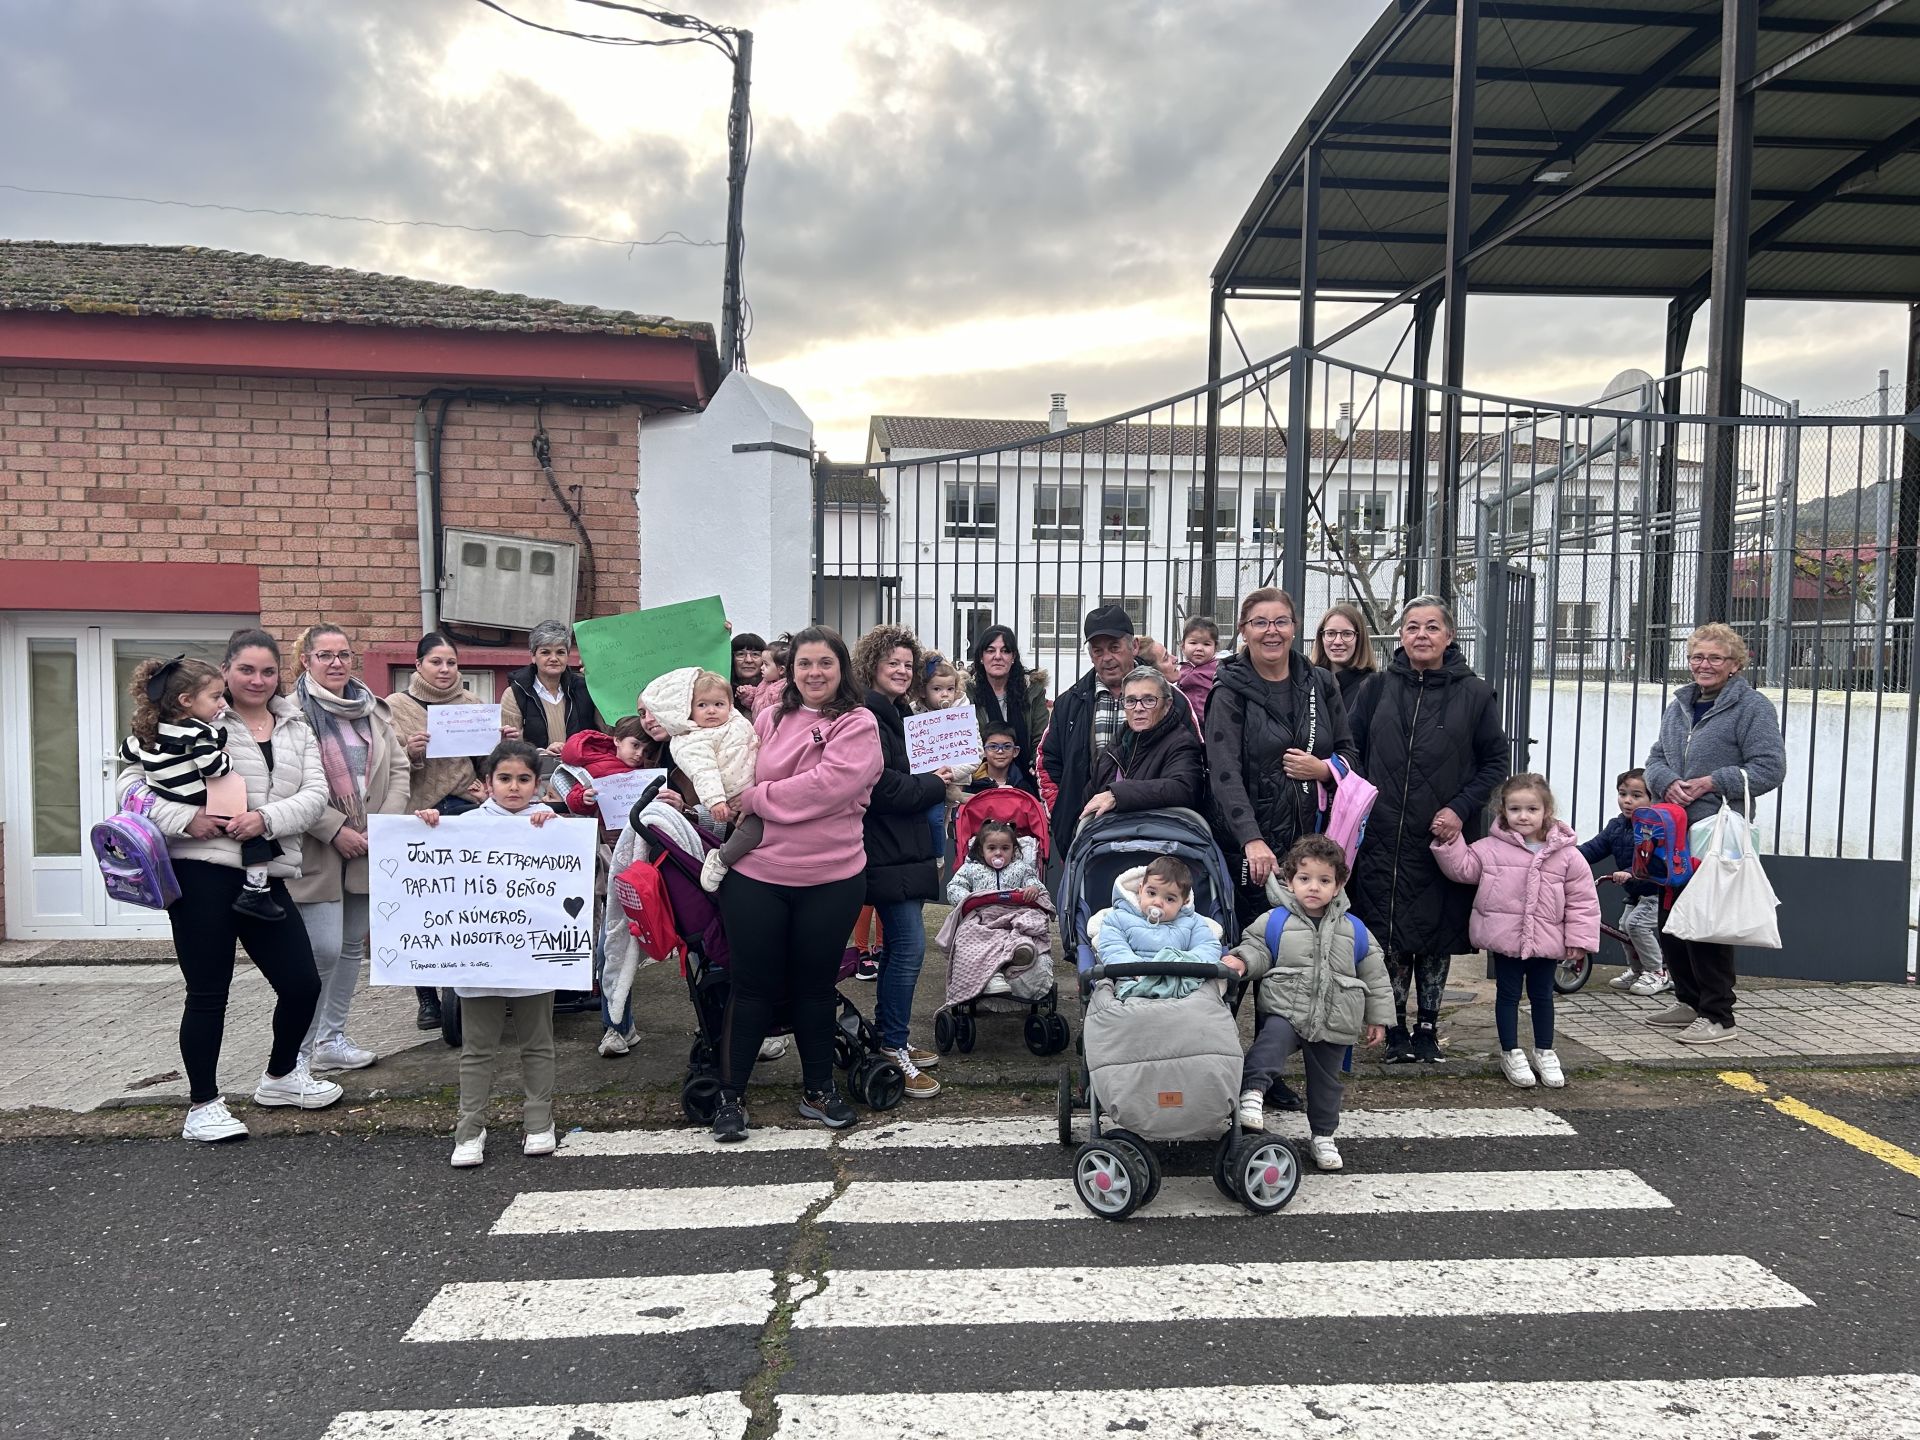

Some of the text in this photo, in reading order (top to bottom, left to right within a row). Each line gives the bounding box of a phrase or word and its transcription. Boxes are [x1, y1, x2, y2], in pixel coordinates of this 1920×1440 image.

[908, 718, 941, 730] QUERIDOS
[911, 730, 972, 749] NO QUEREMOS
[939, 740, 968, 750] NUEVAS
[960, 748, 978, 756] AÑOS
[407, 841, 581, 872] JUNTA DE EXTREMADURA
[506, 877, 557, 898] SEÑOS
[423, 905, 532, 929] SON NÚMEROS,
[400, 933, 443, 950] PARA
[451, 931, 526, 950] NOSOTROS
